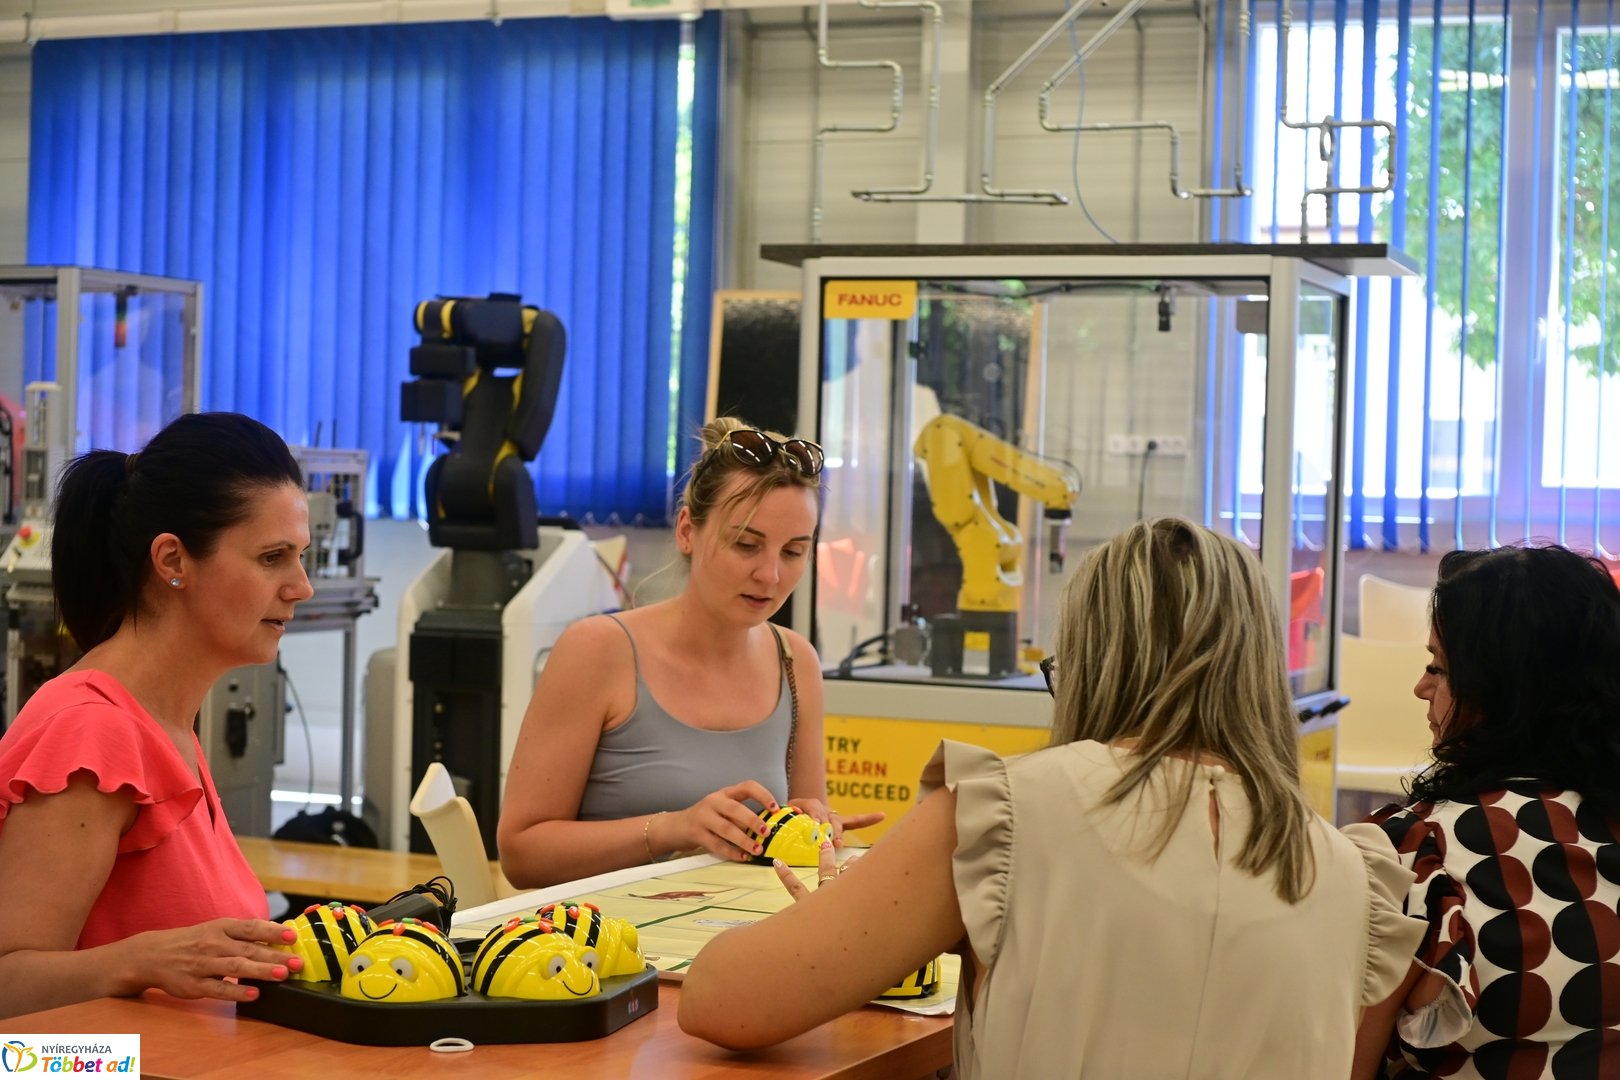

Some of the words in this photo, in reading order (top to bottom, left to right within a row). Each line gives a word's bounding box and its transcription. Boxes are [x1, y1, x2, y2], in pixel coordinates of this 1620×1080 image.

[837, 293, 902, 307] FANUC
[826, 736, 861, 753] TRY
[826, 759, 887, 777] LEARN
[826, 780, 911, 802] SUCCEED
